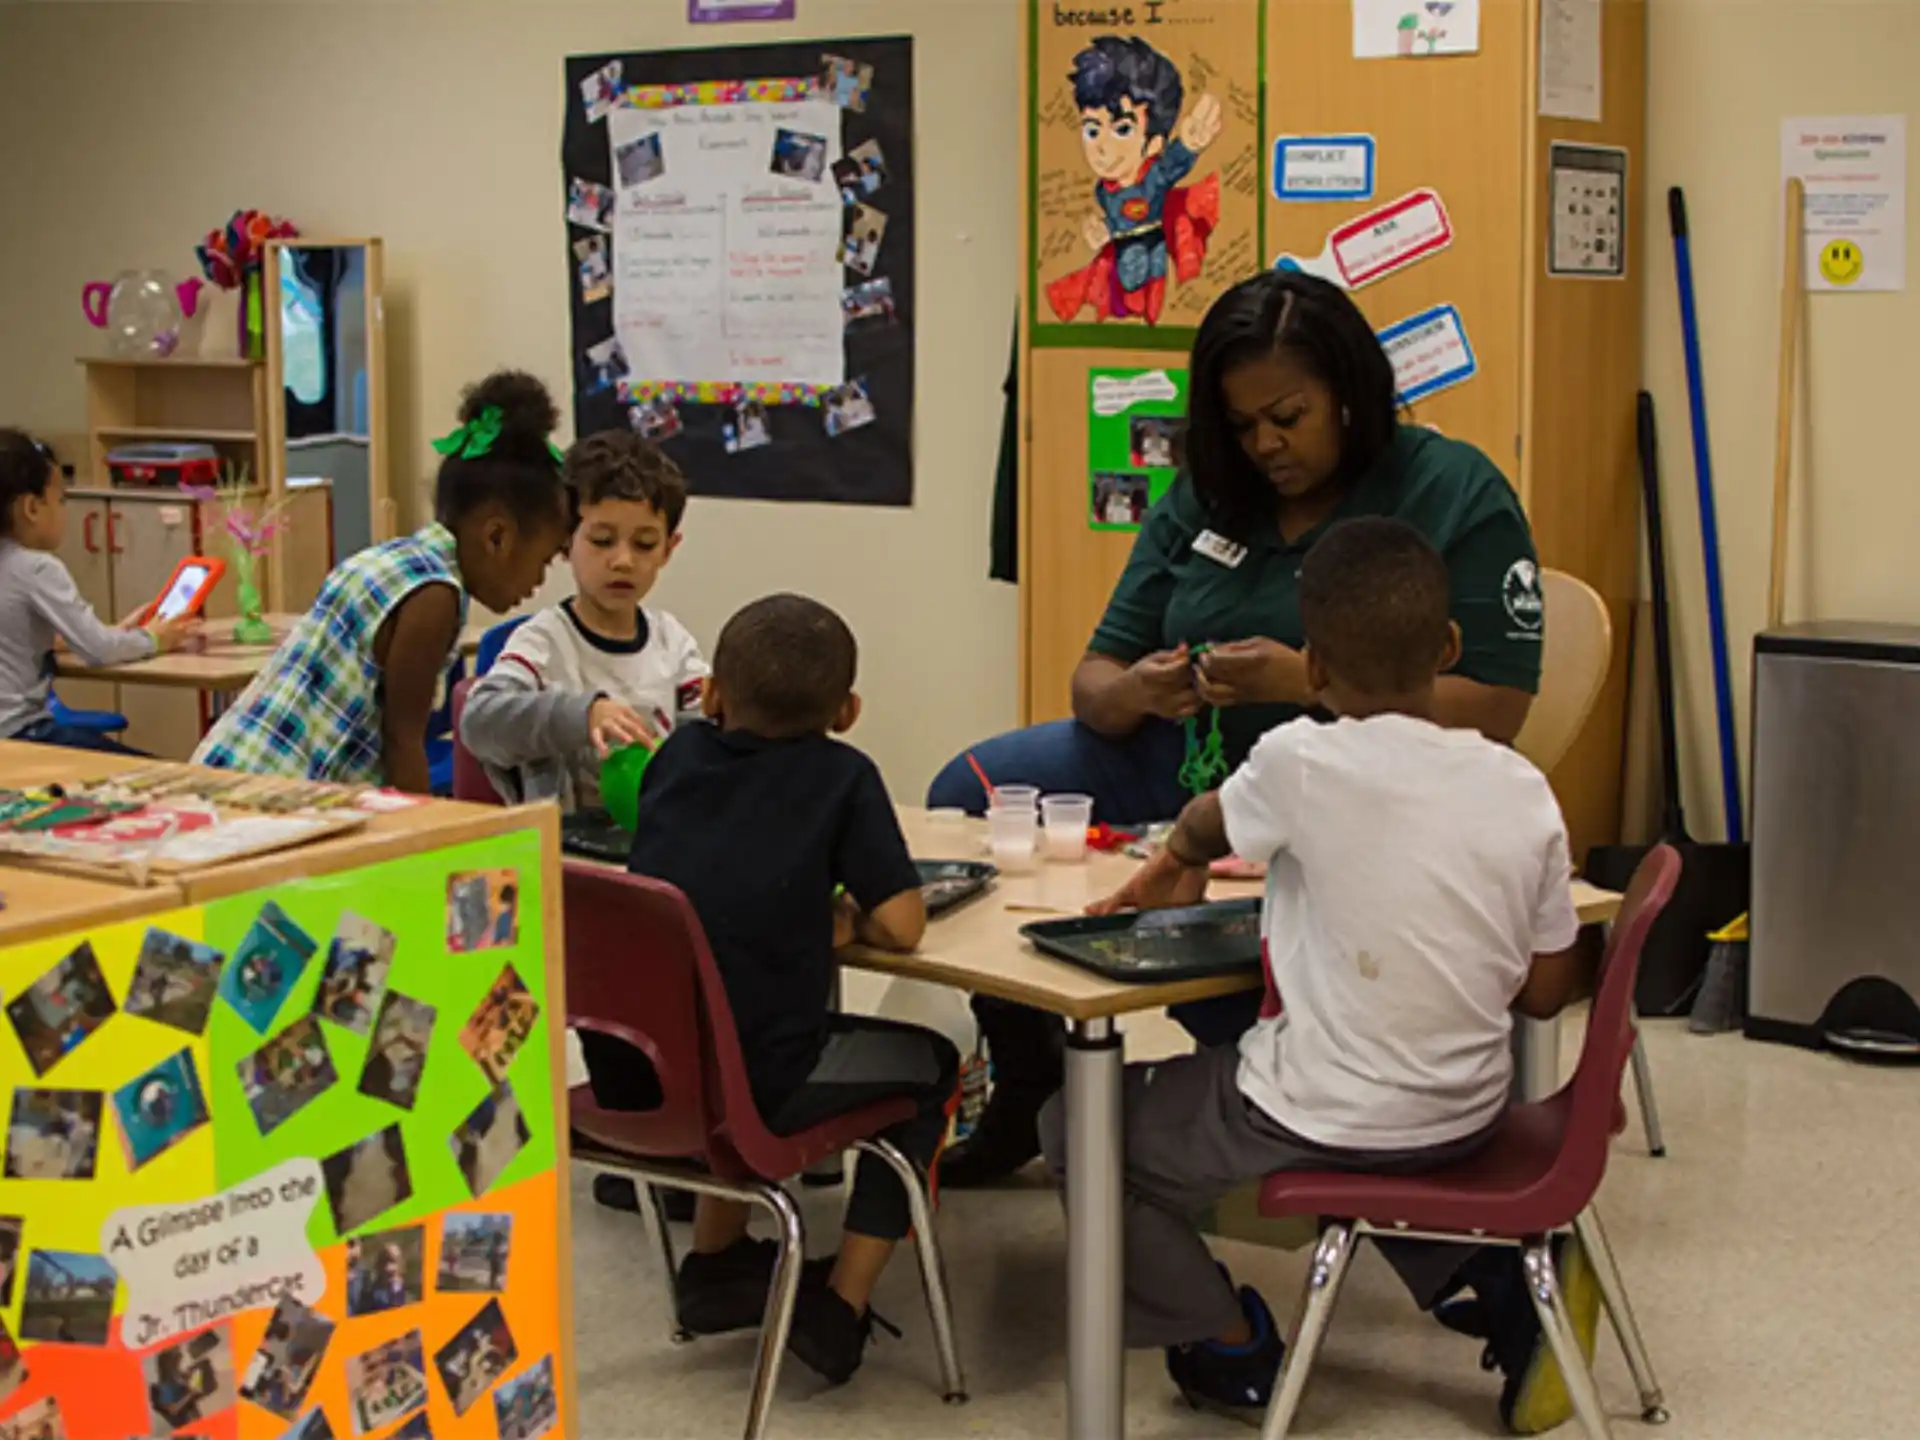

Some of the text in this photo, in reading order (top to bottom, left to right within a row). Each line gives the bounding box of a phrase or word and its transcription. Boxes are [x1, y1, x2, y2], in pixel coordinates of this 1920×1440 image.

[1055, 0, 1135, 27] because
[110, 1224, 135, 1253] A
[137, 1200, 225, 1248] Glimpse
[278, 1174, 316, 1203] the
[173, 1234, 260, 1280] day of a
